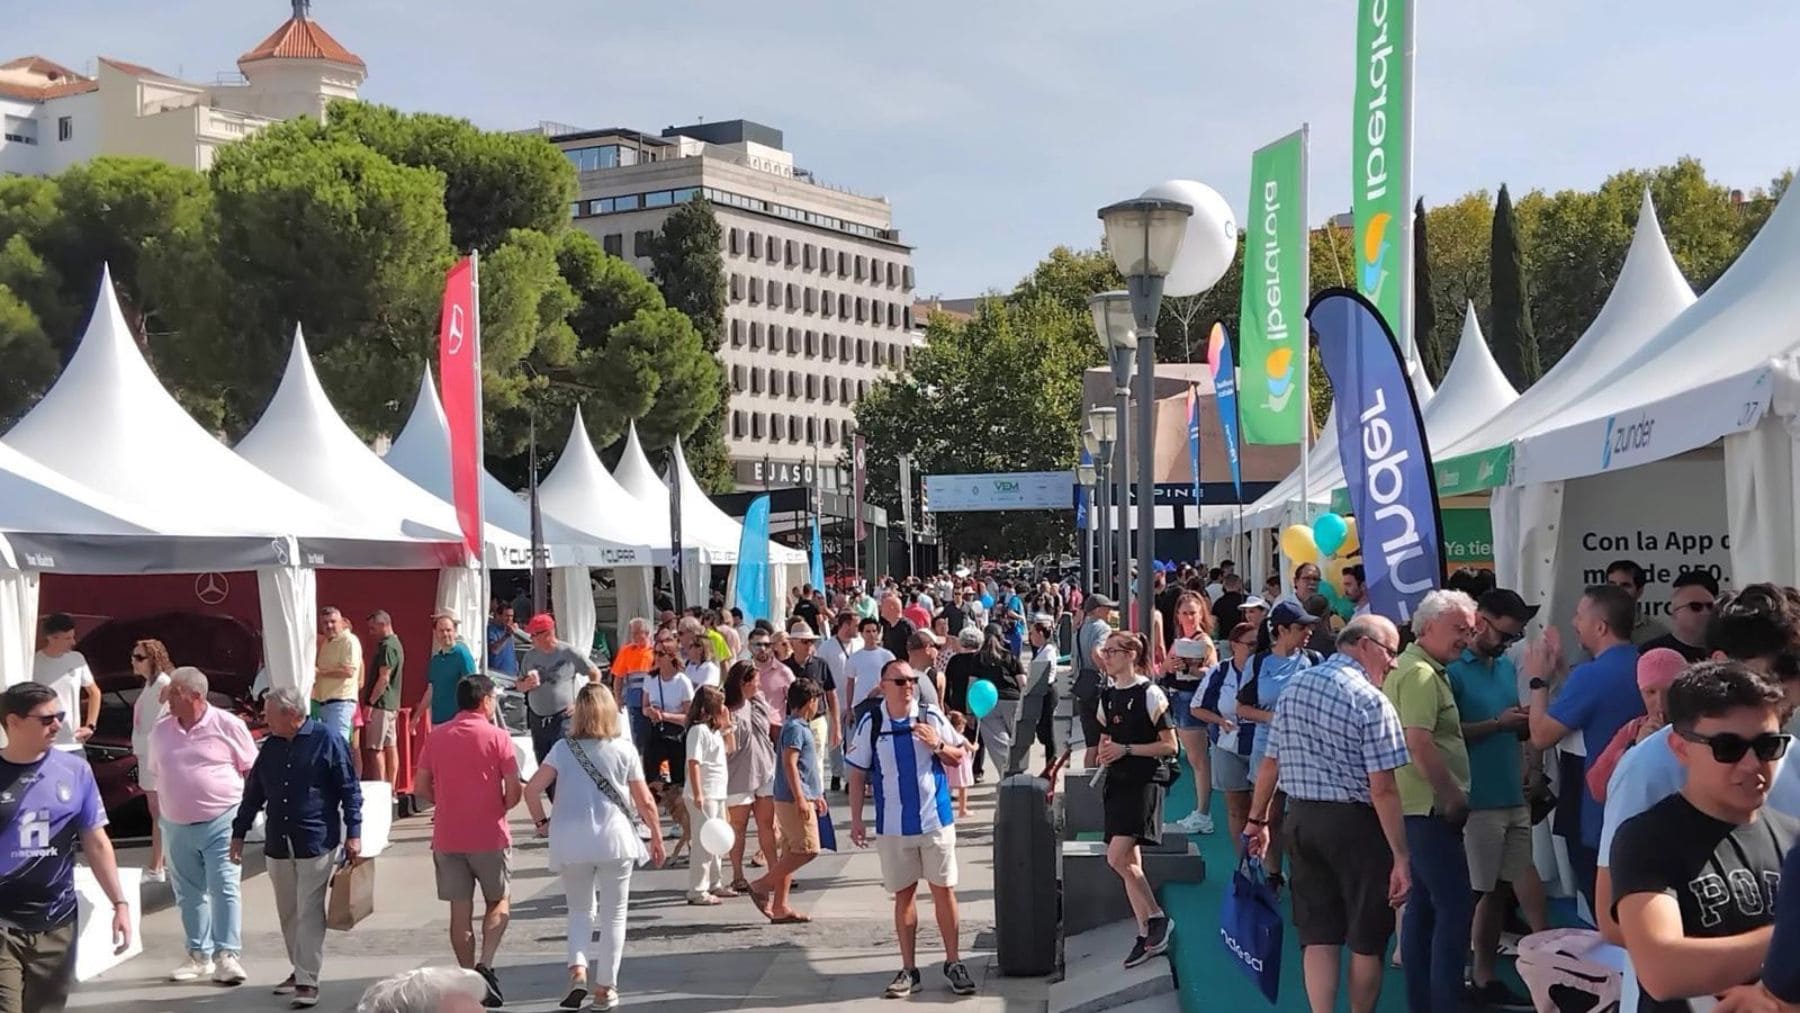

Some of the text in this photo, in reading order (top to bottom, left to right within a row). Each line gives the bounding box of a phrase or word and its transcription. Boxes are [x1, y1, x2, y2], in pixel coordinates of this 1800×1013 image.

[1613, 412, 1656, 454] zunder
[754, 462, 813, 484] EJASO
[1444, 541, 1465, 556] Ya
[1582, 532, 1629, 552] Con
[1637, 531, 1658, 551] la
[1665, 531, 1714, 555] App
